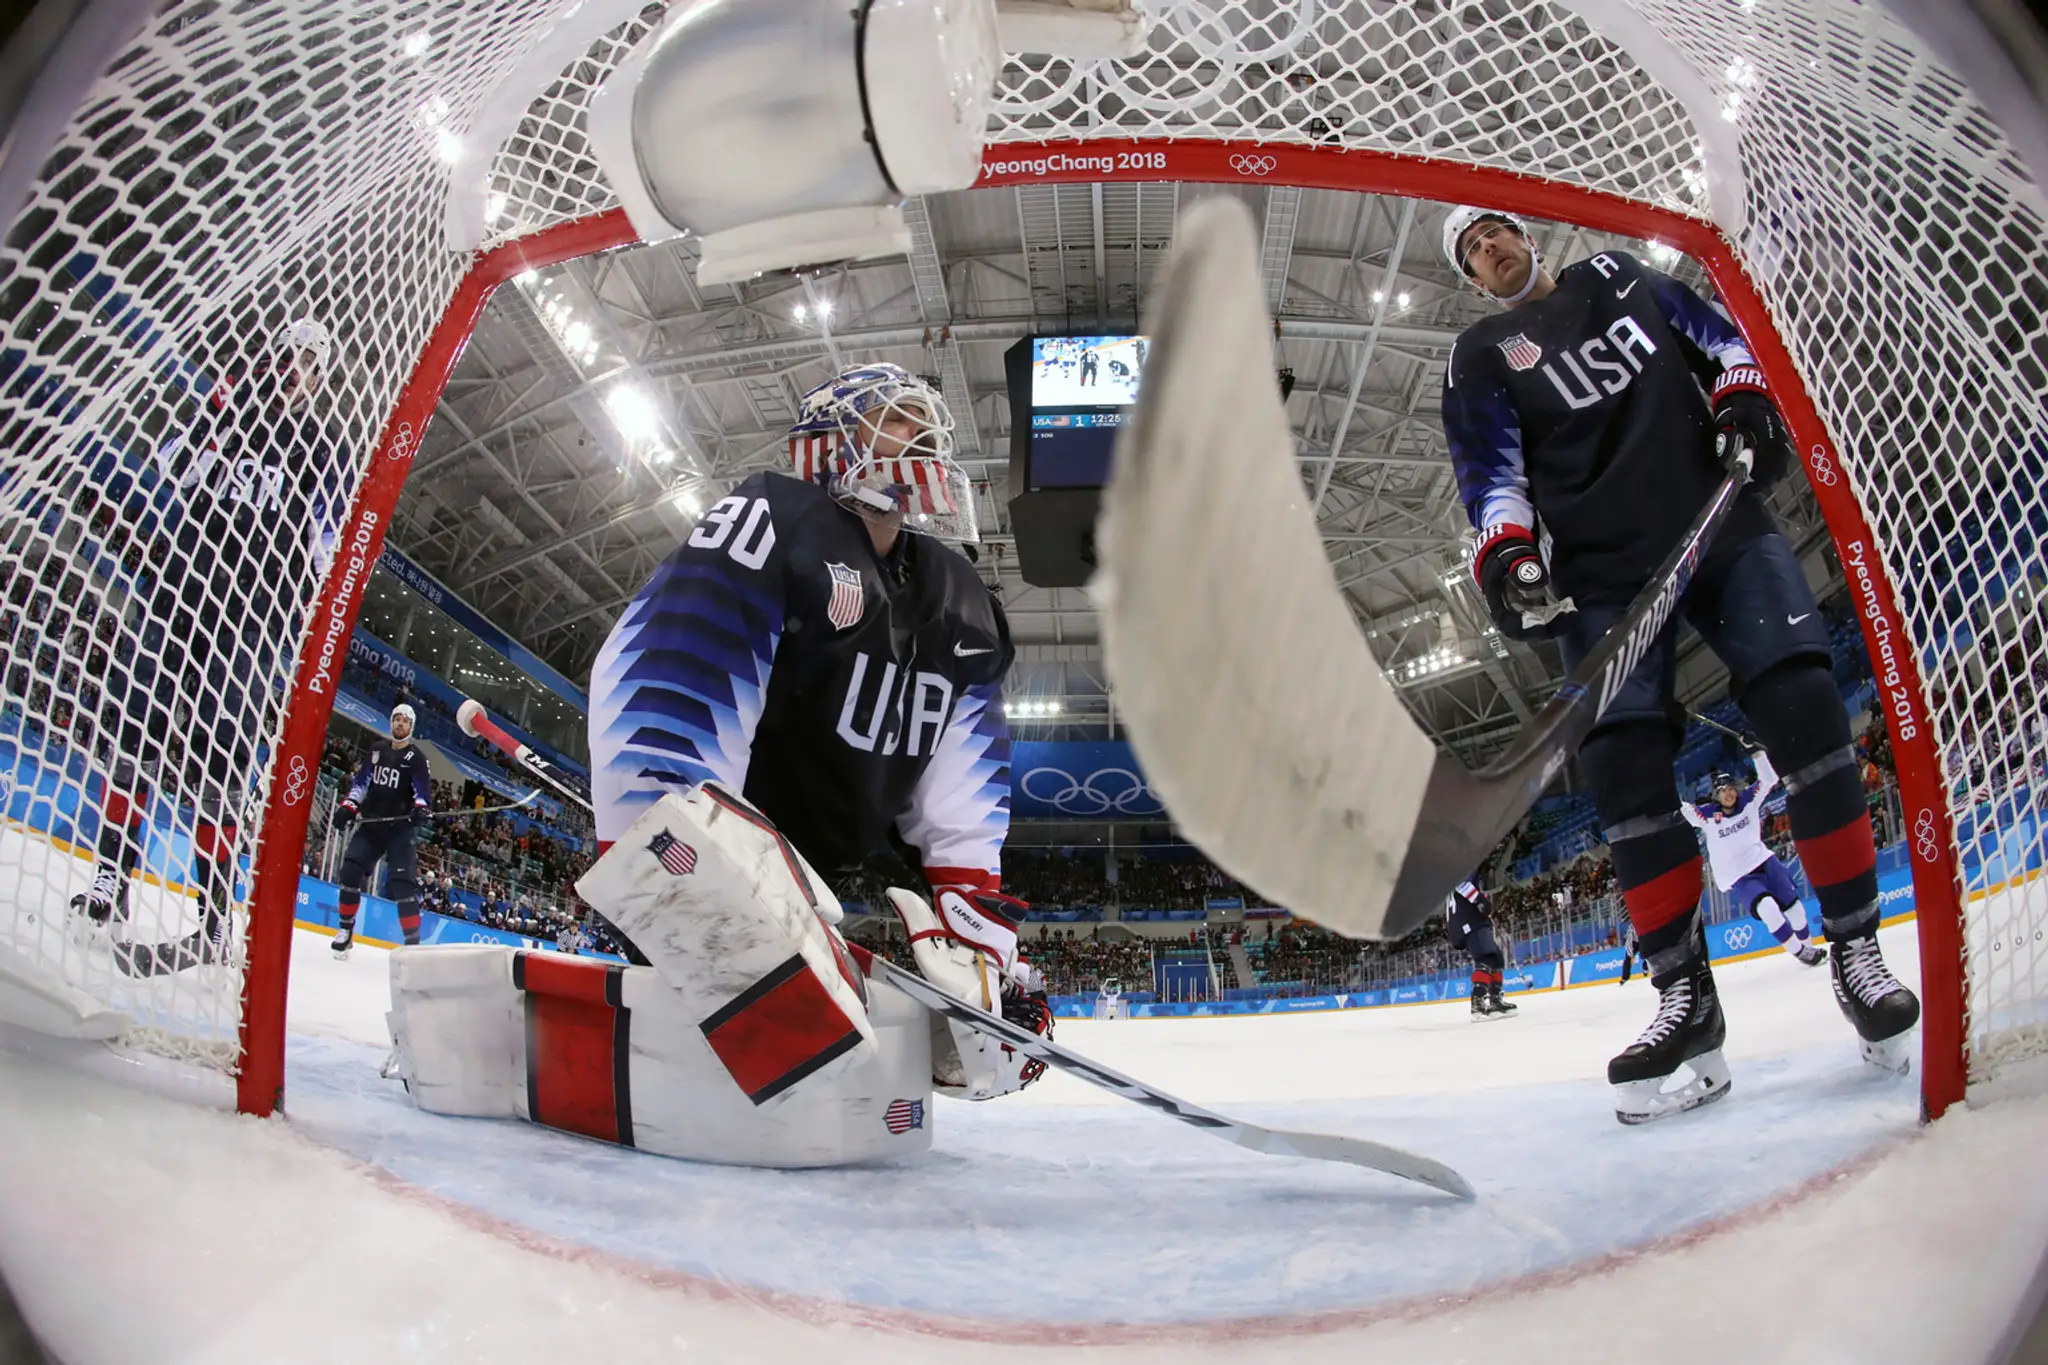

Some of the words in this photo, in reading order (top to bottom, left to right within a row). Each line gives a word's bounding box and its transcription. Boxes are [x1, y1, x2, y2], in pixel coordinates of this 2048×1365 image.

[981, 154, 1114, 180] yeongChang
[1117, 152, 1167, 170] 2018
[1591, 253, 1619, 280] A
[1542, 315, 1657, 410] USA
[1714, 368, 1768, 394] WAR
[1033, 418, 1052, 427] USA
[1075, 416, 1085, 427] 1
[687, 496, 776, 571] 30
[834, 567, 858, 584] USA
[308, 556, 365, 695] PyeongChang
[351, 510, 379, 557] 2018
[1847, 540, 1900, 687] PyeongChang
[1890, 687, 1917, 742] 2018
[382, 654, 416, 686] 2018
[373, 764, 401, 789] USA
[297, 890, 309, 905] 18
[1878, 881, 1914, 905] Pyeong
[951, 904, 984, 932] ZAPOLSKI
[912, 1103, 921, 1125] USA
